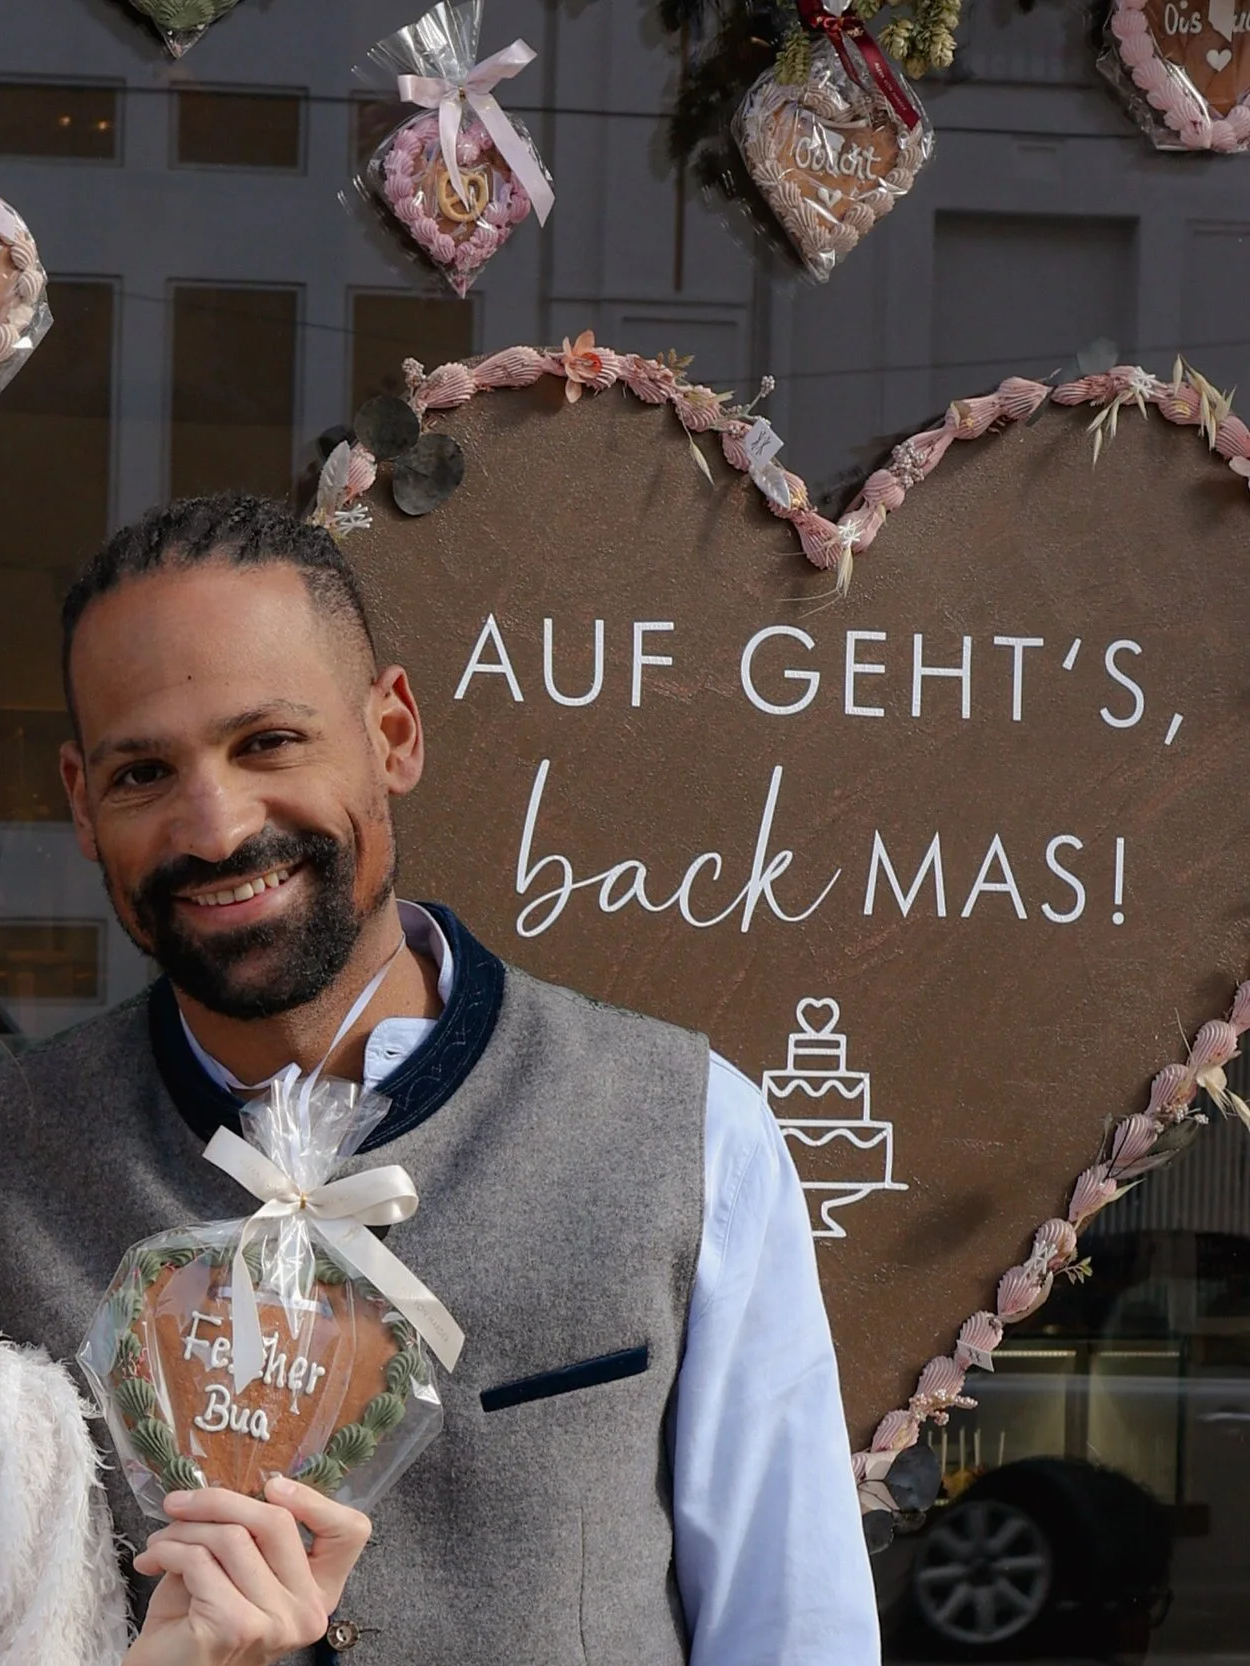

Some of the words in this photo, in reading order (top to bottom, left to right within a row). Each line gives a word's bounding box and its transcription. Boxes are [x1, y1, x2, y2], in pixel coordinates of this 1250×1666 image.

[453, 613, 675, 708] AUF
[516, 758, 842, 938] back
[862, 828, 1126, 926] MAS!
[184, 1310, 326, 1394] Feher
[194, 1384, 271, 1441] Bua
